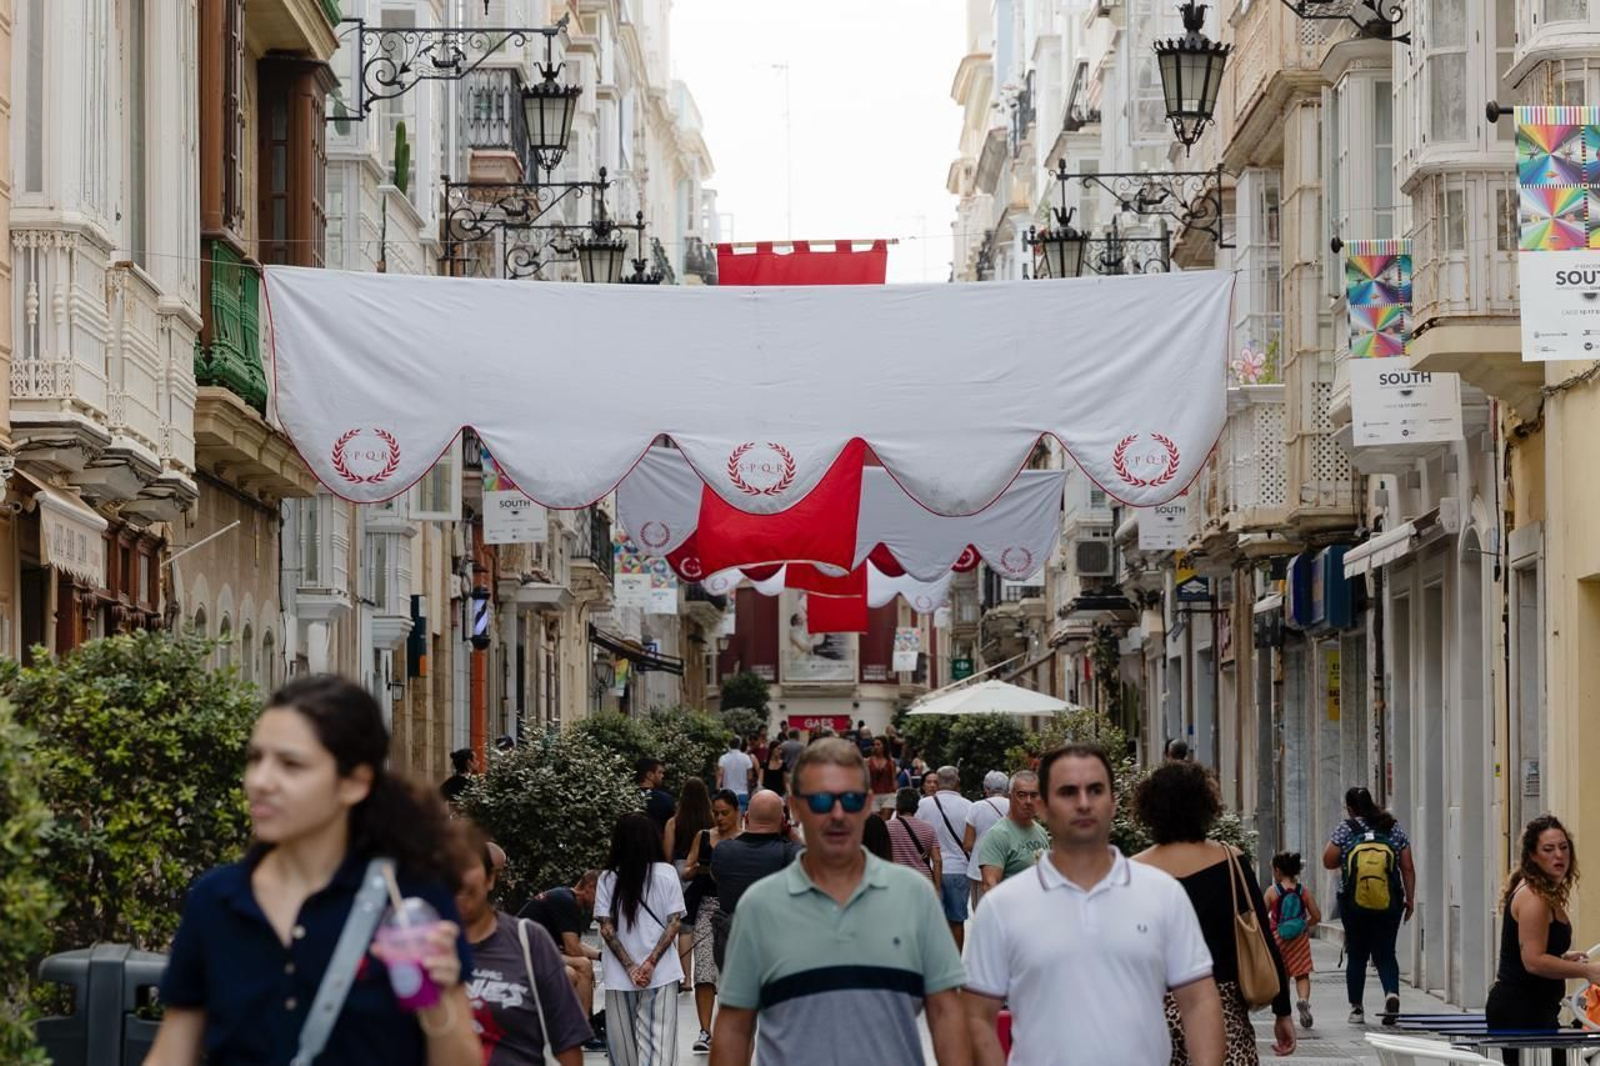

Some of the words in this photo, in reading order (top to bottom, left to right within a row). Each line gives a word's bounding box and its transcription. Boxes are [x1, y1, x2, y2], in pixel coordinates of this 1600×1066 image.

[1379, 372, 1432, 386] SOUTH
[499, 499, 531, 508] SOUTH
[1154, 505, 1186, 514] SOUTH
[804, 717, 834, 728] GAES
